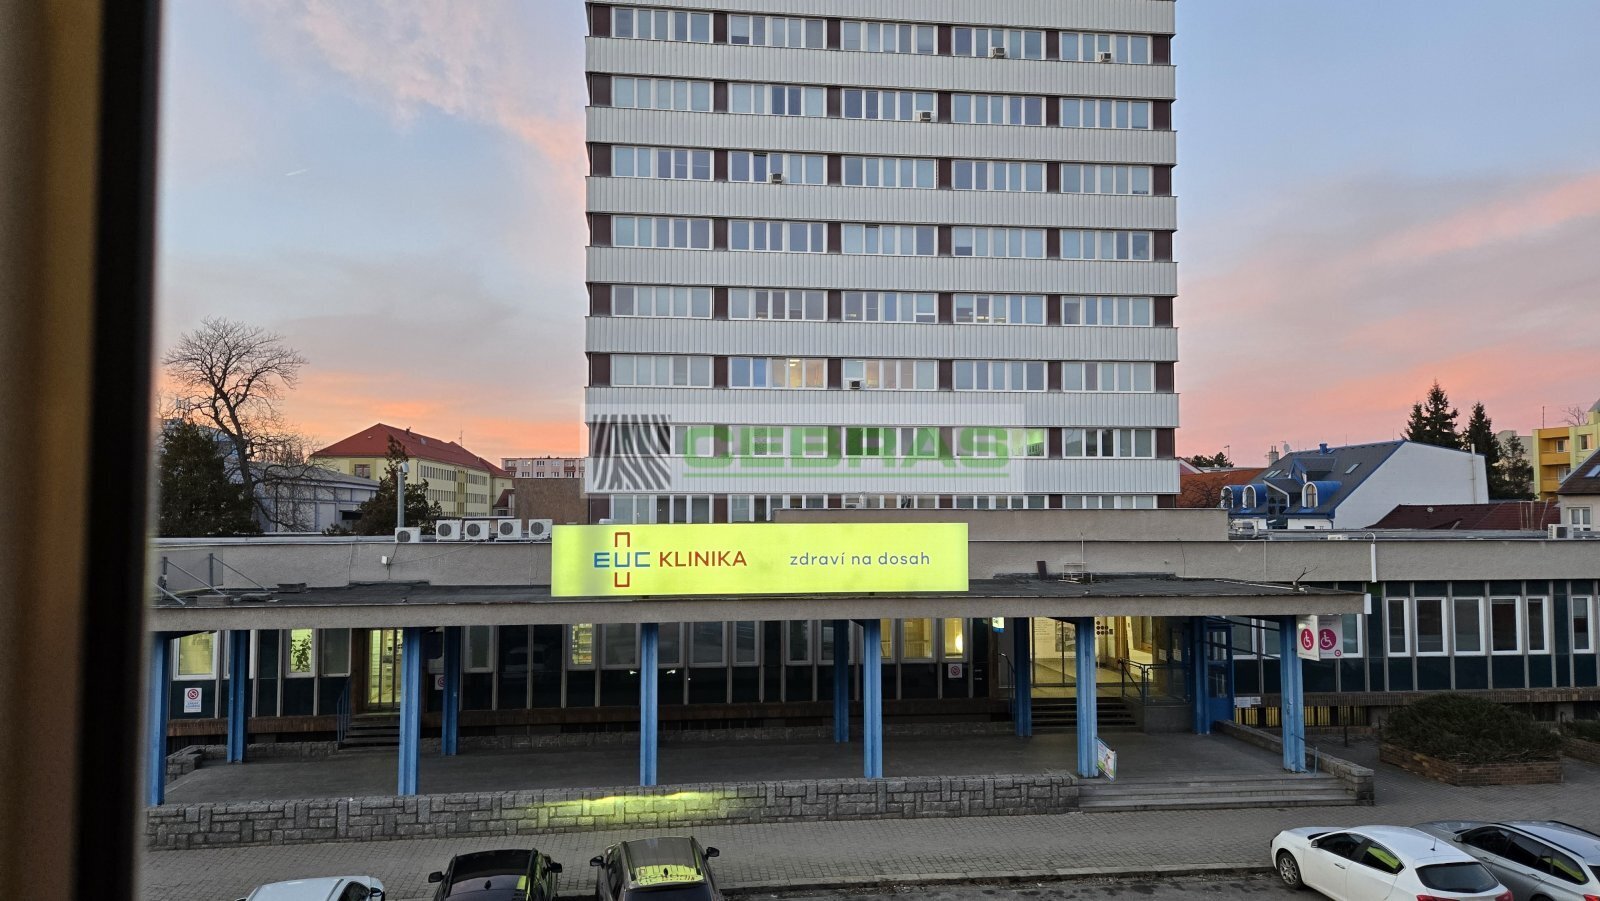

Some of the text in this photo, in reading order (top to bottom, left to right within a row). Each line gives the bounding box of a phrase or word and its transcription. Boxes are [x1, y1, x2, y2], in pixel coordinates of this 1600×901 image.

[593, 550, 748, 568] EUC KLINIKA
[790, 551, 930, 565] zdraví na dosah
